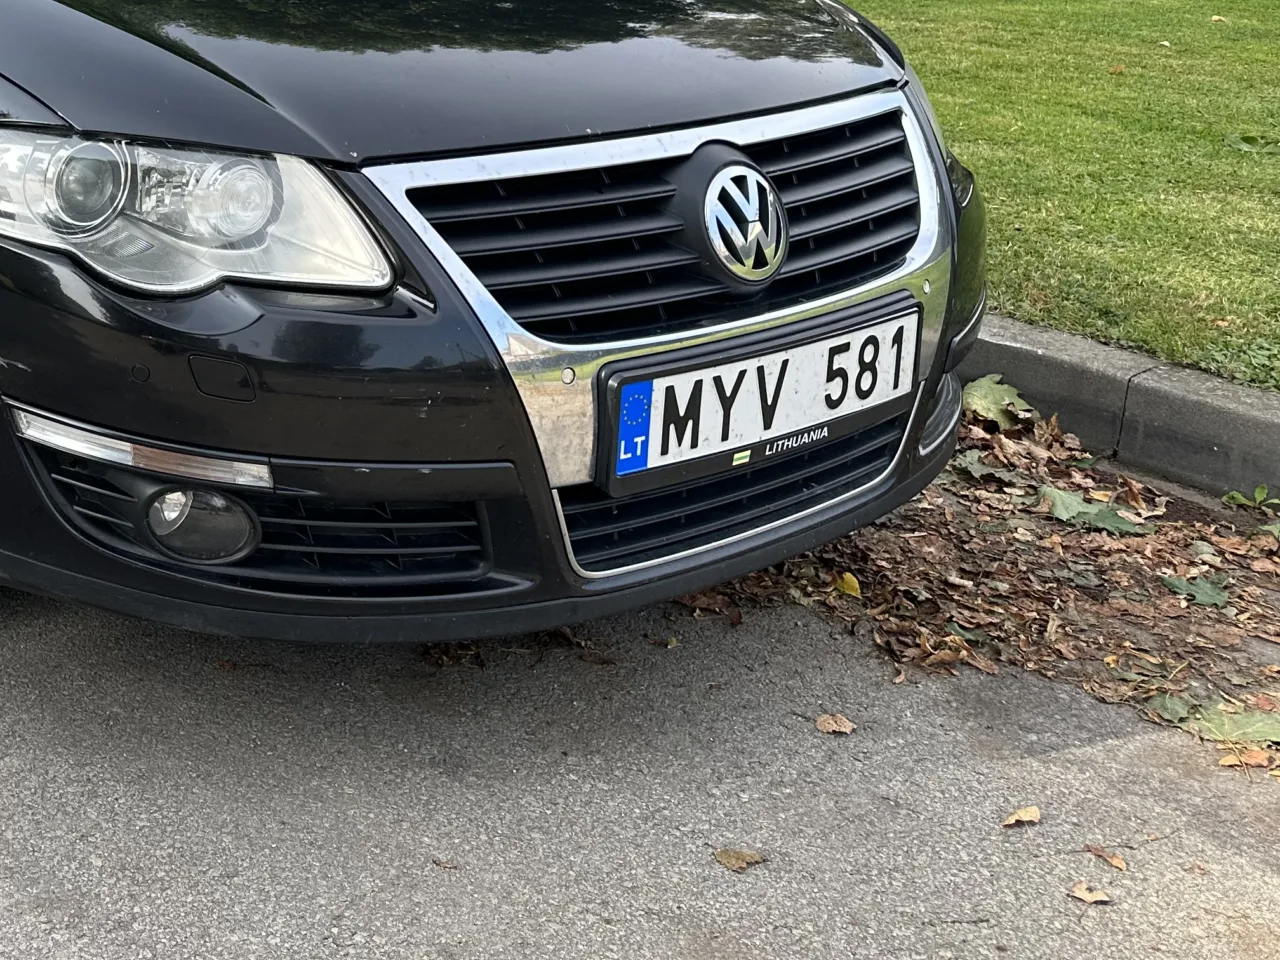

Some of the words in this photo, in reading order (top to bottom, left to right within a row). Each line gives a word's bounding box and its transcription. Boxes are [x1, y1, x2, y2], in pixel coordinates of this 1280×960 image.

[660, 358, 789, 456] MYV
[824, 325, 904, 410] 581
[619, 435, 646, 460] LT
[765, 426, 828, 455] LITHUANIA
